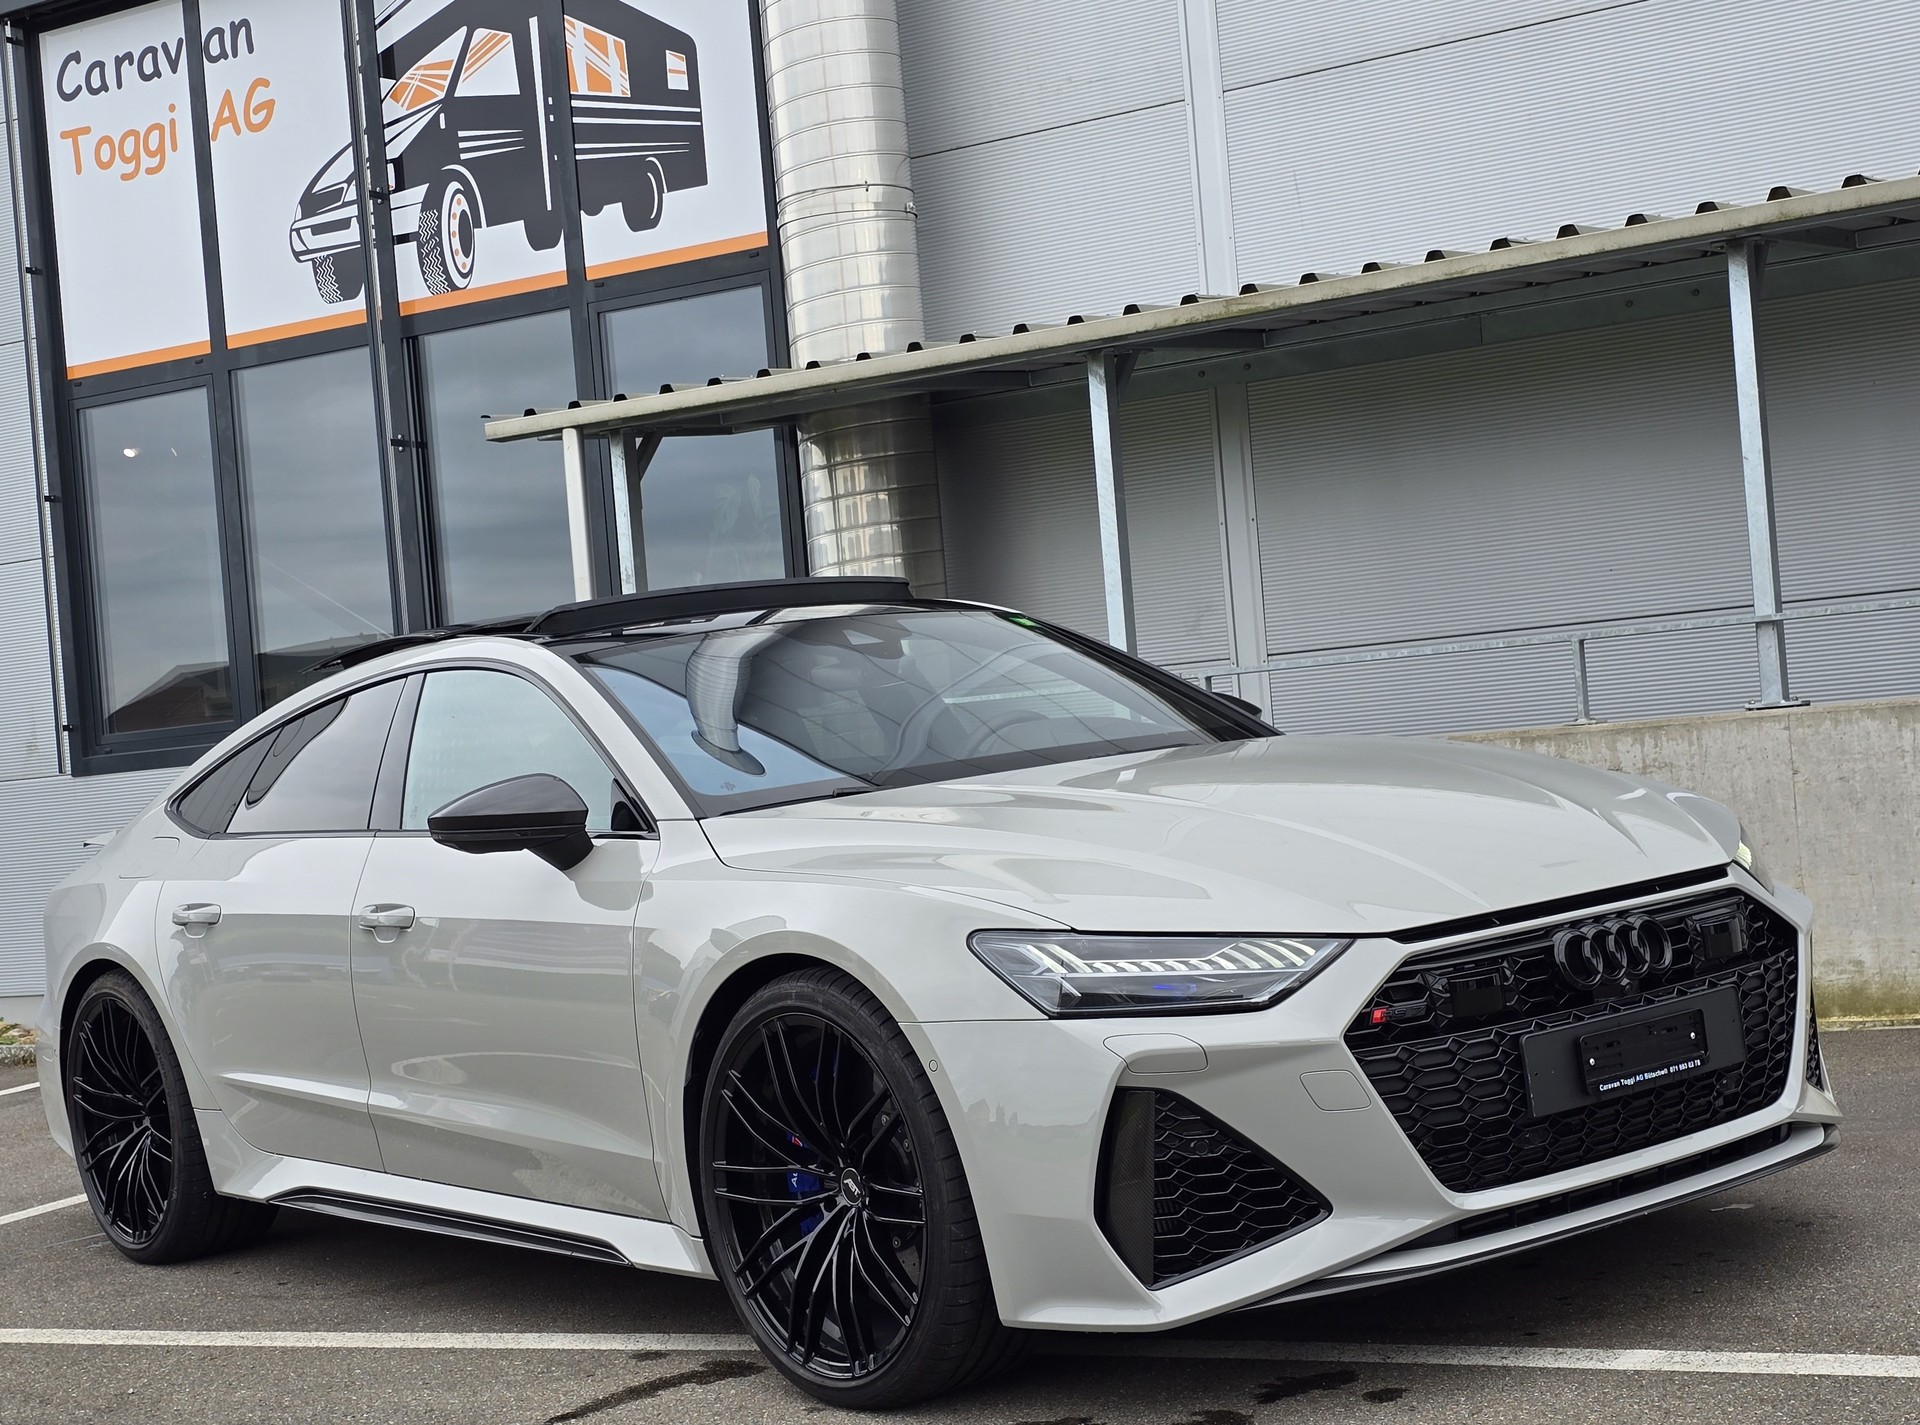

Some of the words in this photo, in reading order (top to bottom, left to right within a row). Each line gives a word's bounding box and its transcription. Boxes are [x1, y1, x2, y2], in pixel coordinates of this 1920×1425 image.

[56, 18, 254, 102] Caravan
[59, 102, 179, 183] Toggi
[210, 76, 276, 143] AG
[1599, 1082, 1620, 1091] Caravan
